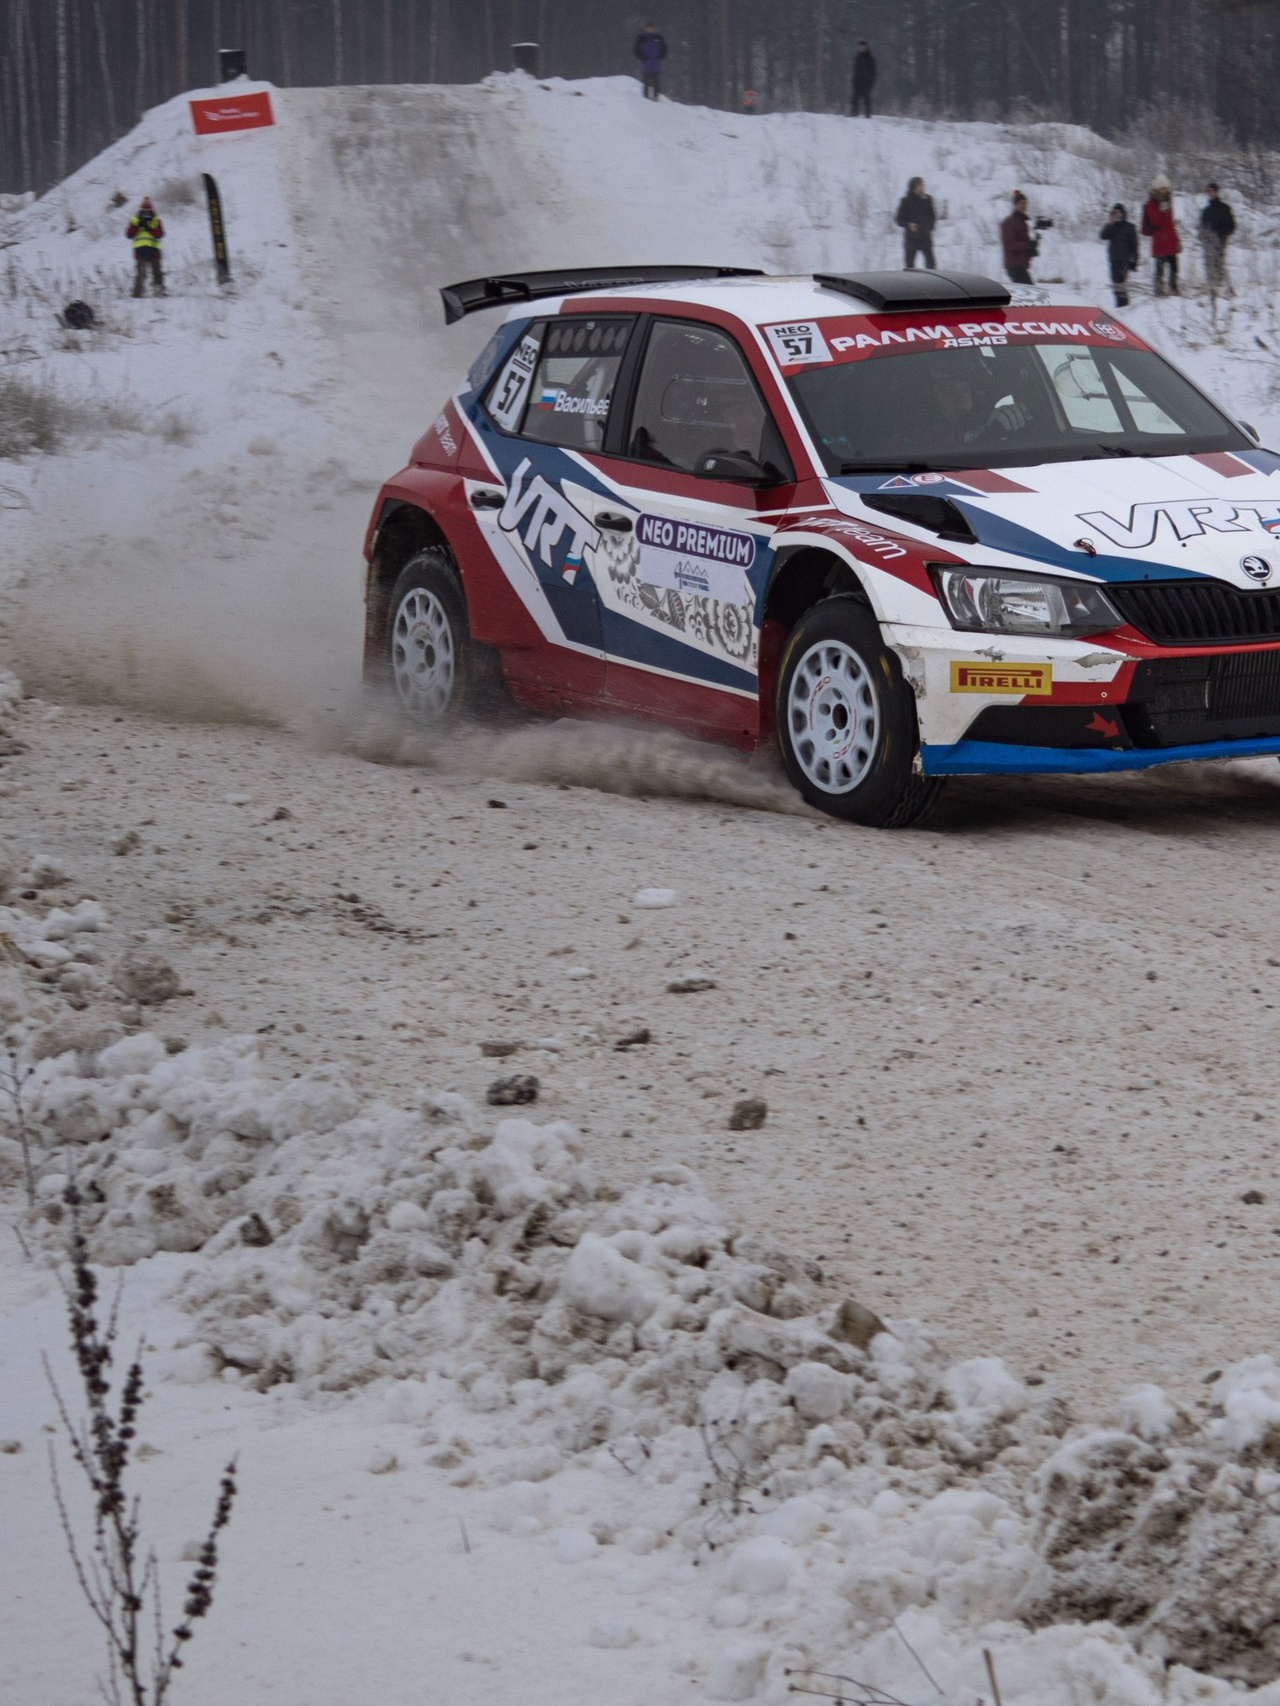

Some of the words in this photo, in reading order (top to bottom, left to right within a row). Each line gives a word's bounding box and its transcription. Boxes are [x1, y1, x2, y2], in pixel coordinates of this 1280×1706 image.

[773, 325, 811, 336] NEO
[830, 324, 951, 352] РАЛЛИ
[958, 321, 1091, 337] РОССИИ
[514, 342, 538, 365] NEO
[782, 336, 813, 357] 57
[497, 370, 526, 415] 57
[497, 456, 602, 587] VRT
[641, 517, 674, 546] NEO
[676, 525, 751, 564] PREMIUM
[958, 667, 1044, 689] PIRELLI
